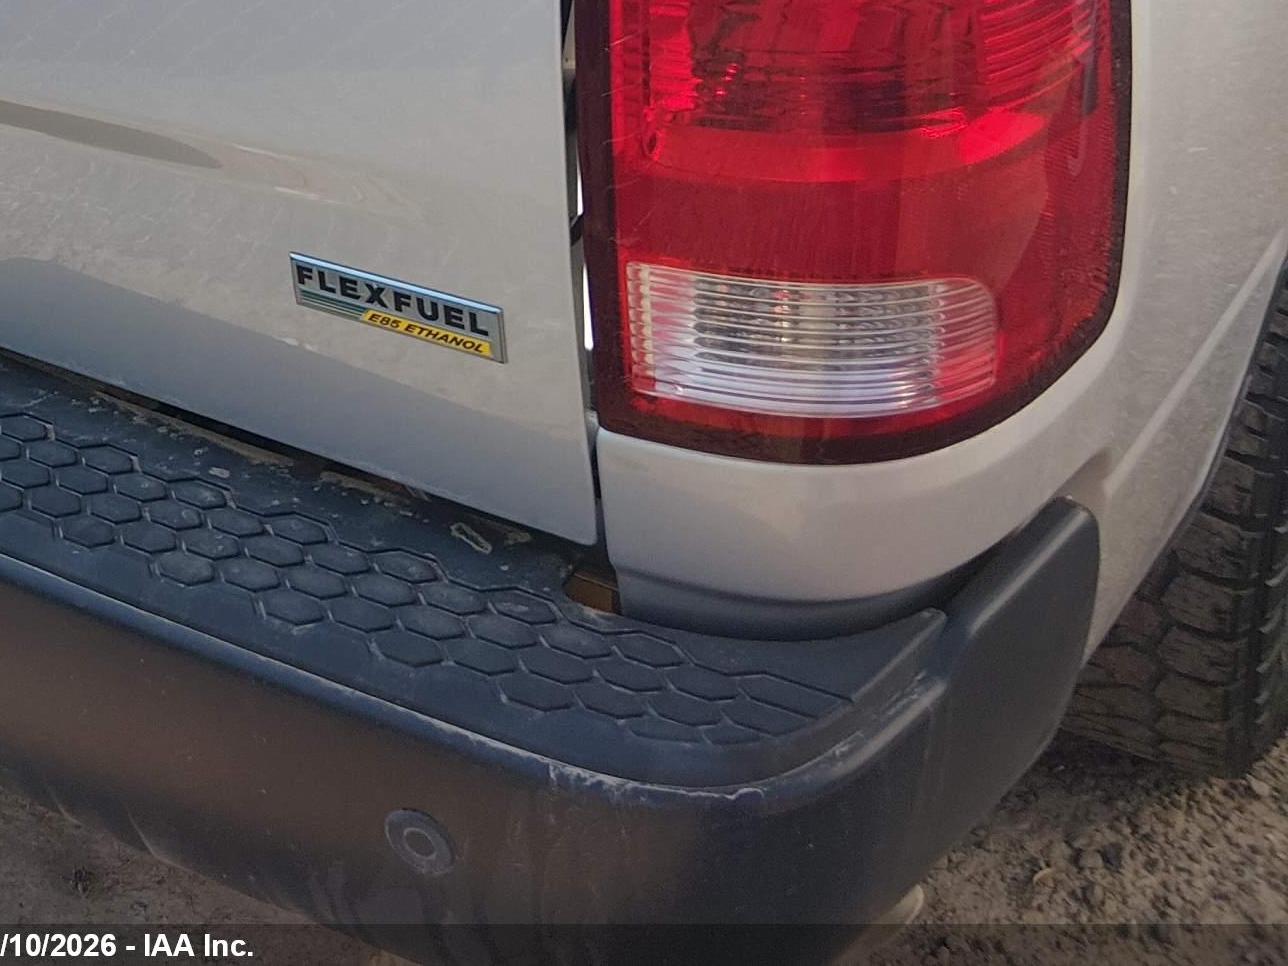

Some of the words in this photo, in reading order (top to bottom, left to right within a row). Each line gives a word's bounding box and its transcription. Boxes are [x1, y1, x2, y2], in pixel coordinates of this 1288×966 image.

[295, 265, 490, 337] FLEXFUEL
[367, 313, 401, 329] E85
[403, 324, 485, 353] ETHANOL
